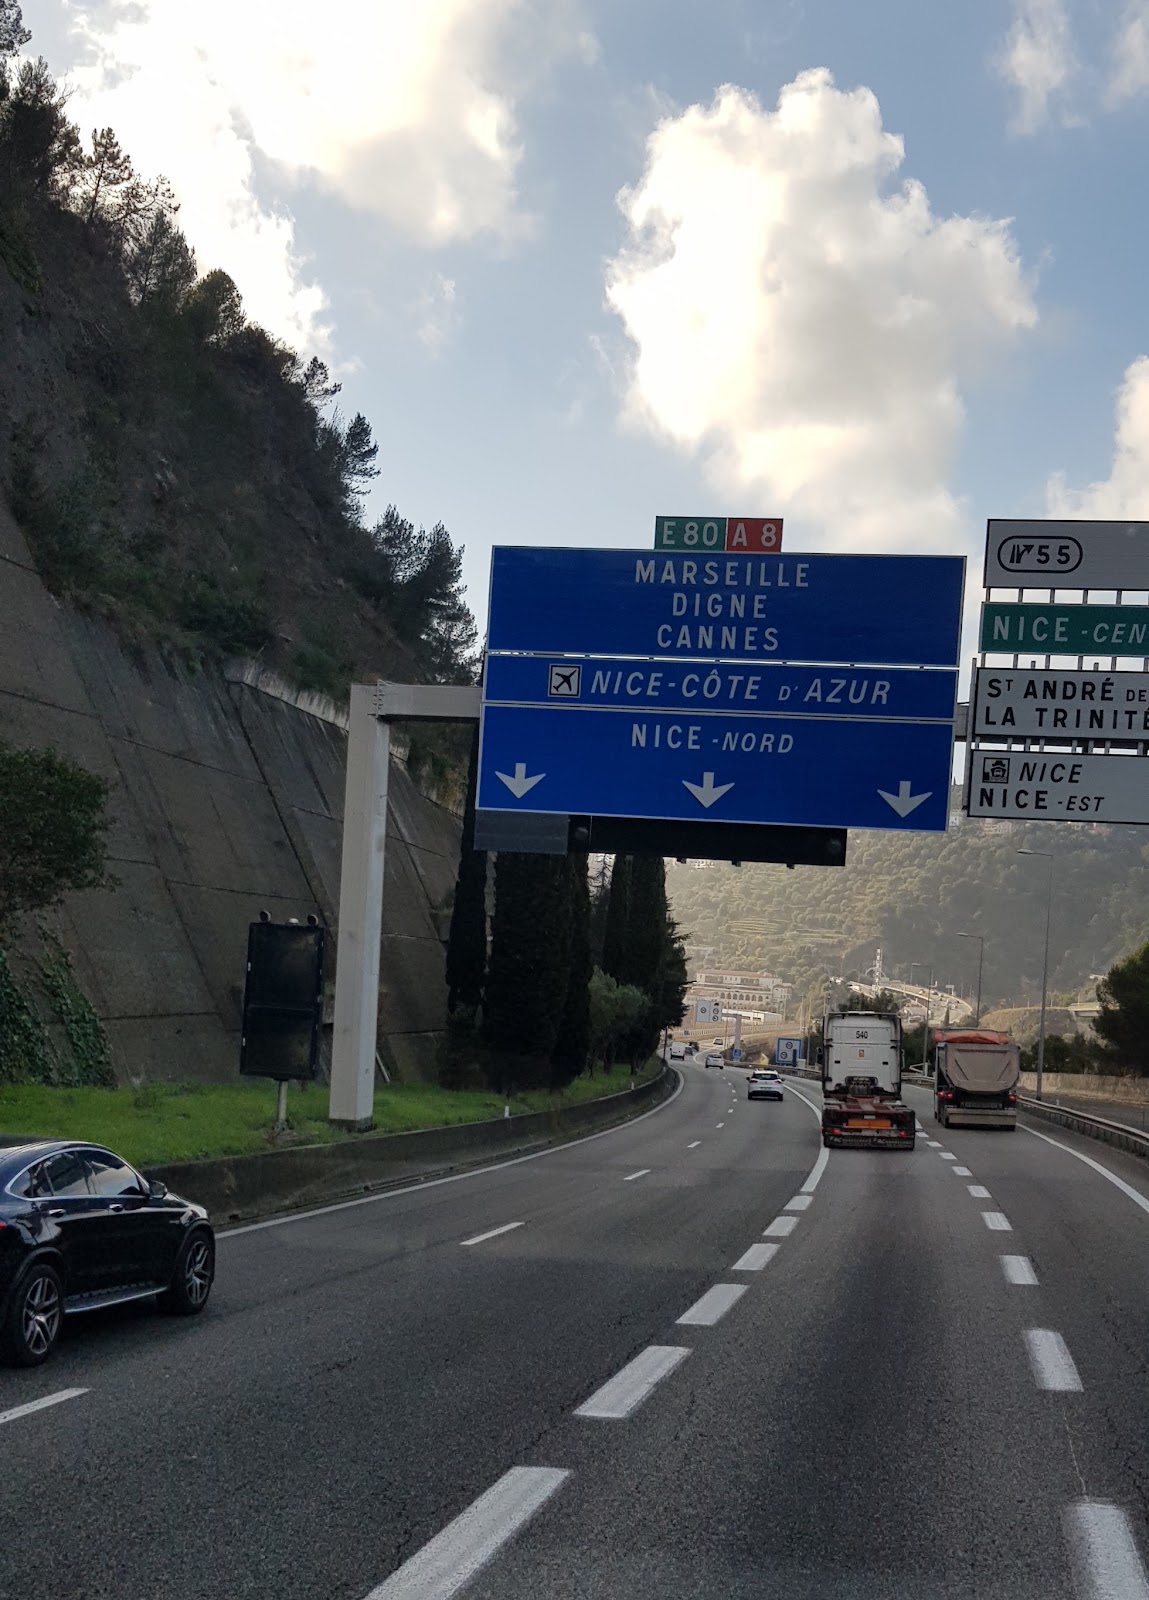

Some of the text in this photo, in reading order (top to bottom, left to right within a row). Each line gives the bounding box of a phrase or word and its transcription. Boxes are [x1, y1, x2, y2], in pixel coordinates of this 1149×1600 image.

[1035, 544, 1071, 565] 55
[635, 559, 810, 588] MARSEILLE
[672, 592, 767, 620] DIGNE
[656, 624, 780, 651] CANNES
[992, 615, 1070, 642] NICE
[590, 668, 763, 702] NICE-CÔTE
[1023, 677, 1115, 702] ANDRÉ
[1125, 688, 1148, 704] DE
[984, 705, 1016, 727] LA
[631, 723, 702, 751] NICE
[1018, 761, 1084, 784] NICE
[979, 787, 1048, 811] NICE
[855, 1030, 869, 1039] 540
